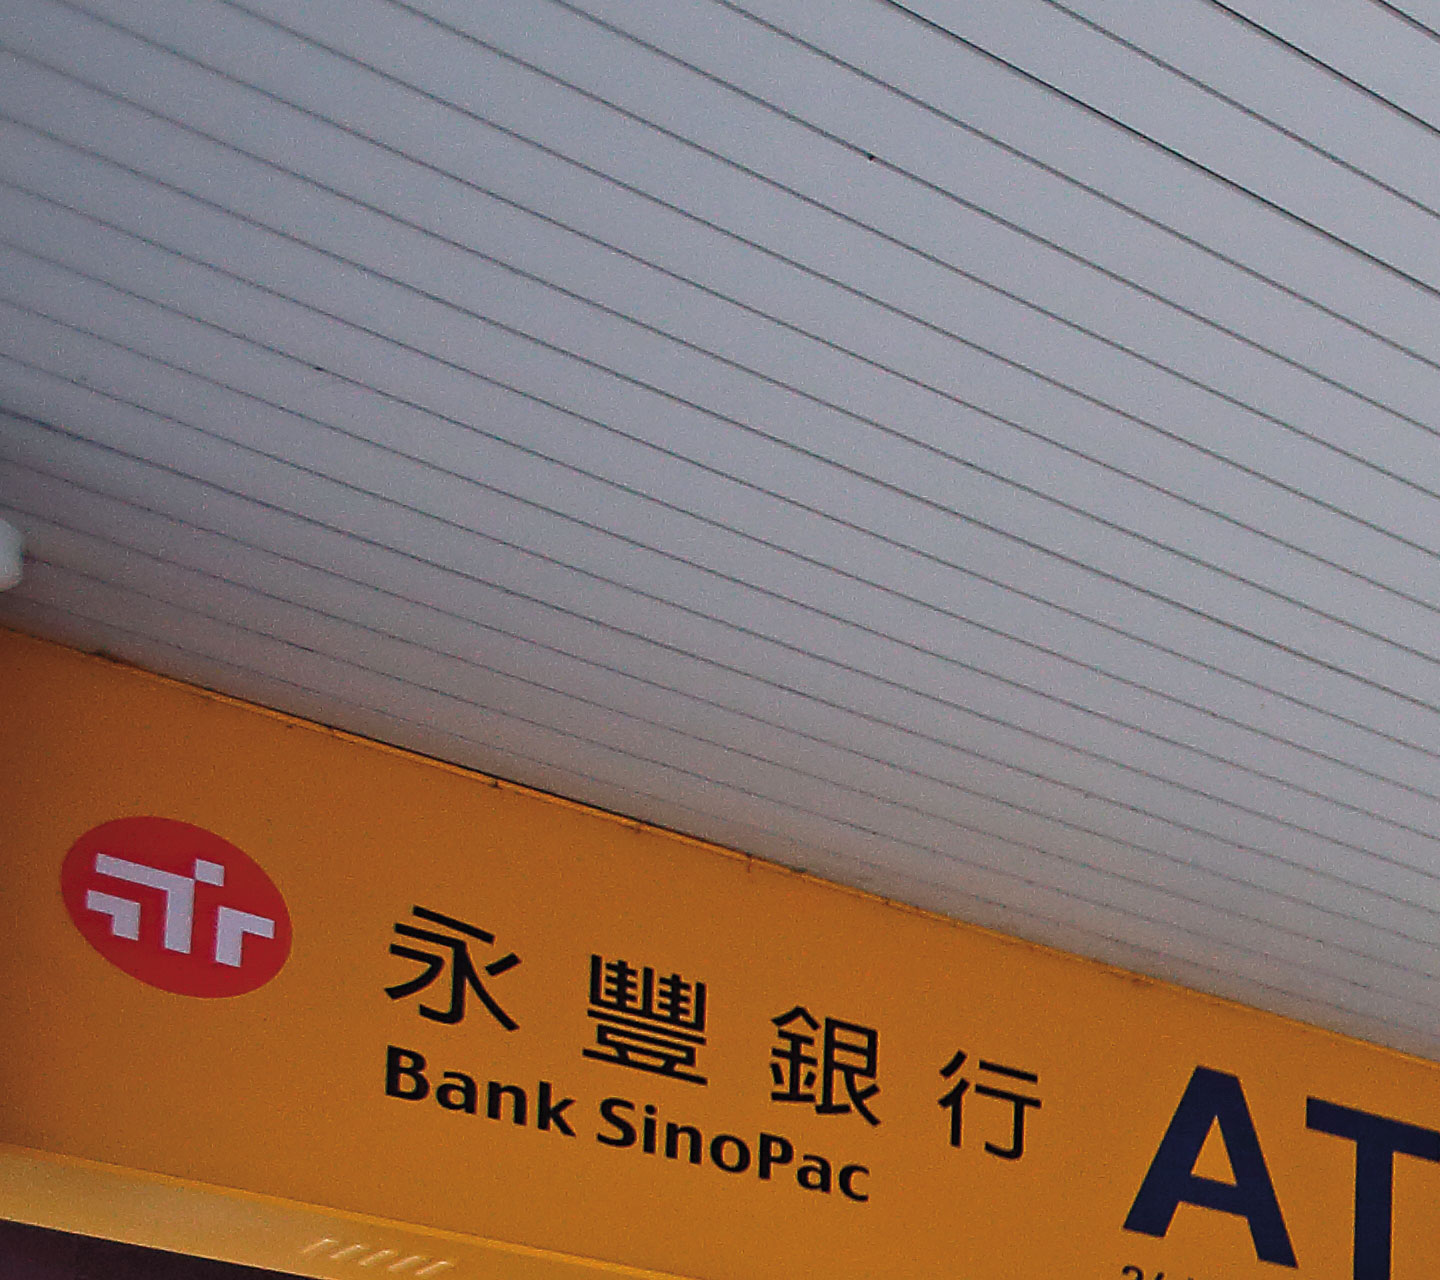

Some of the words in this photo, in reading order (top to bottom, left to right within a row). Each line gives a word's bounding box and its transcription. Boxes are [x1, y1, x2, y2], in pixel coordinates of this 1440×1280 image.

[384, 905, 1043, 1160] 永豐銀行
[385, 1045, 577, 1138] Bank
[597, 1097, 871, 1201] SinoPac
